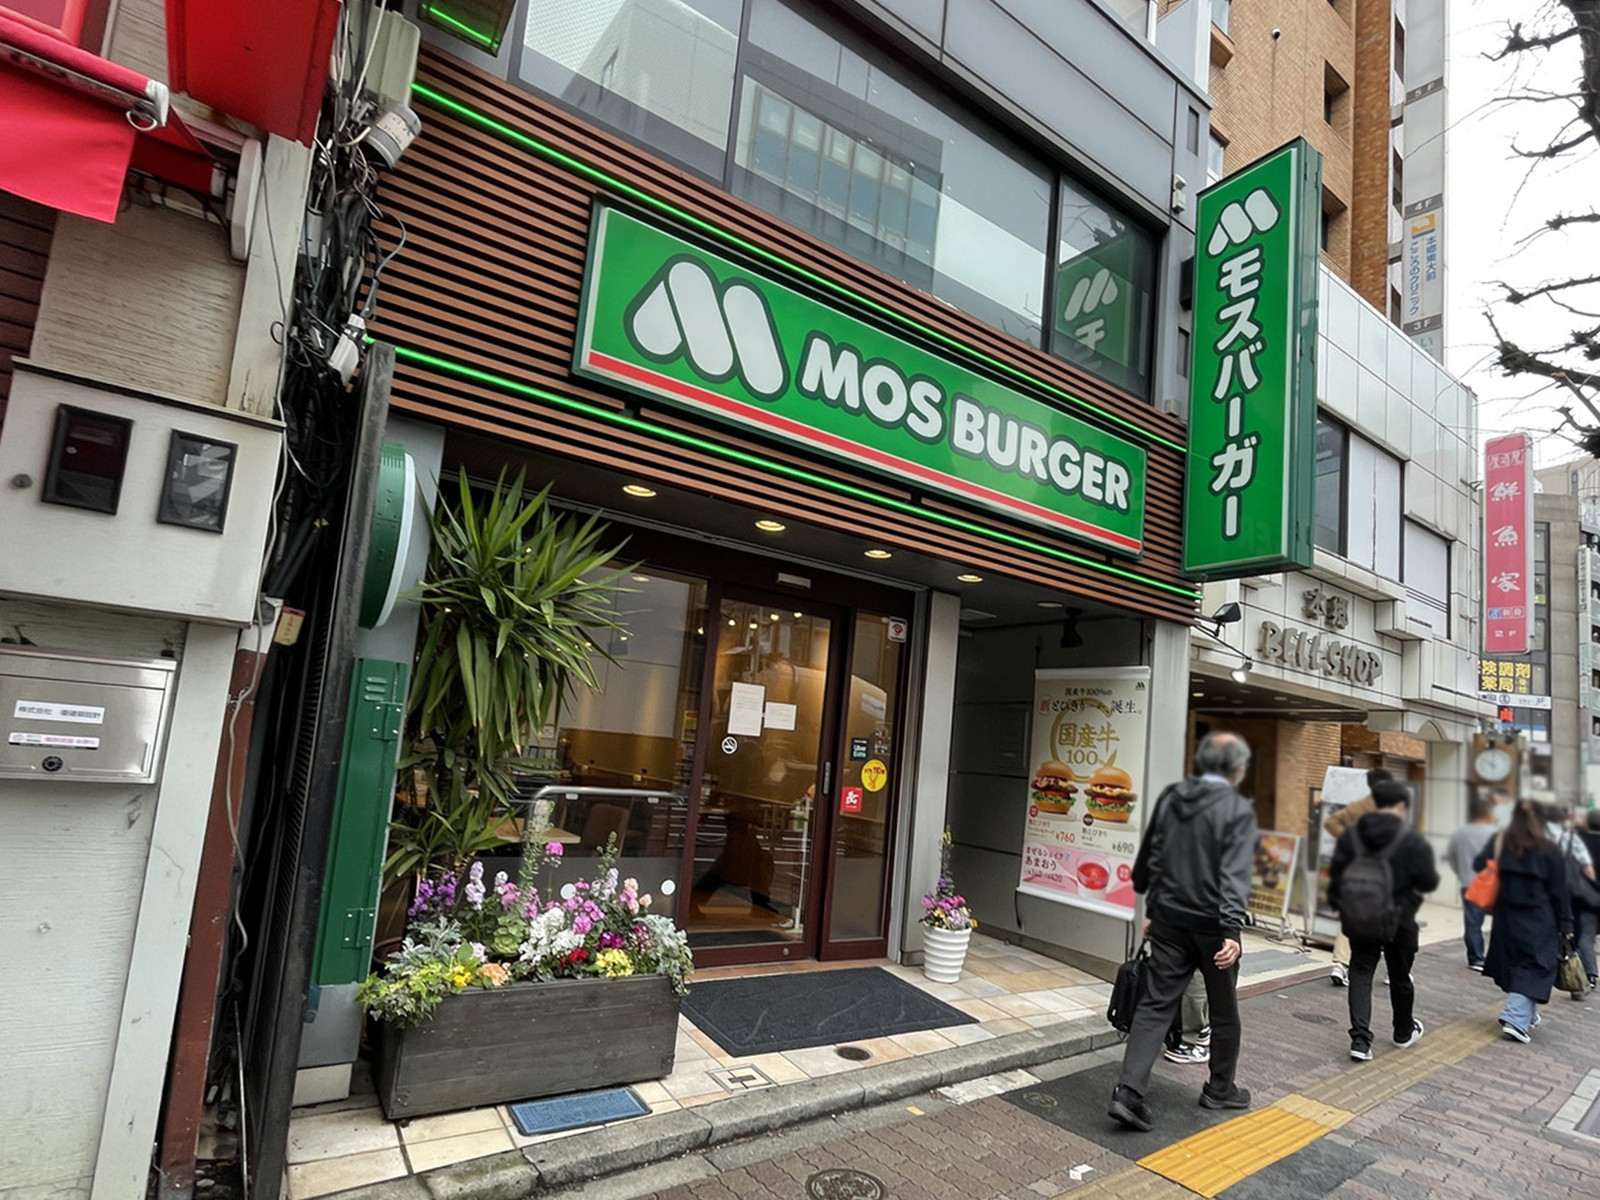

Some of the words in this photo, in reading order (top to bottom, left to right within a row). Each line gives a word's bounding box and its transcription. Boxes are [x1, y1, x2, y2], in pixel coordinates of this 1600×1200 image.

[1212, 247, 1263, 537] モスバーガー
[801, 337, 943, 438] MOS
[952, 398, 1129, 510] BURGER
[1059, 722, 1120, 752] 国産牛
[1025, 856, 1057, 871] あまおう
[1112, 842, 1135, 855] ¥690
